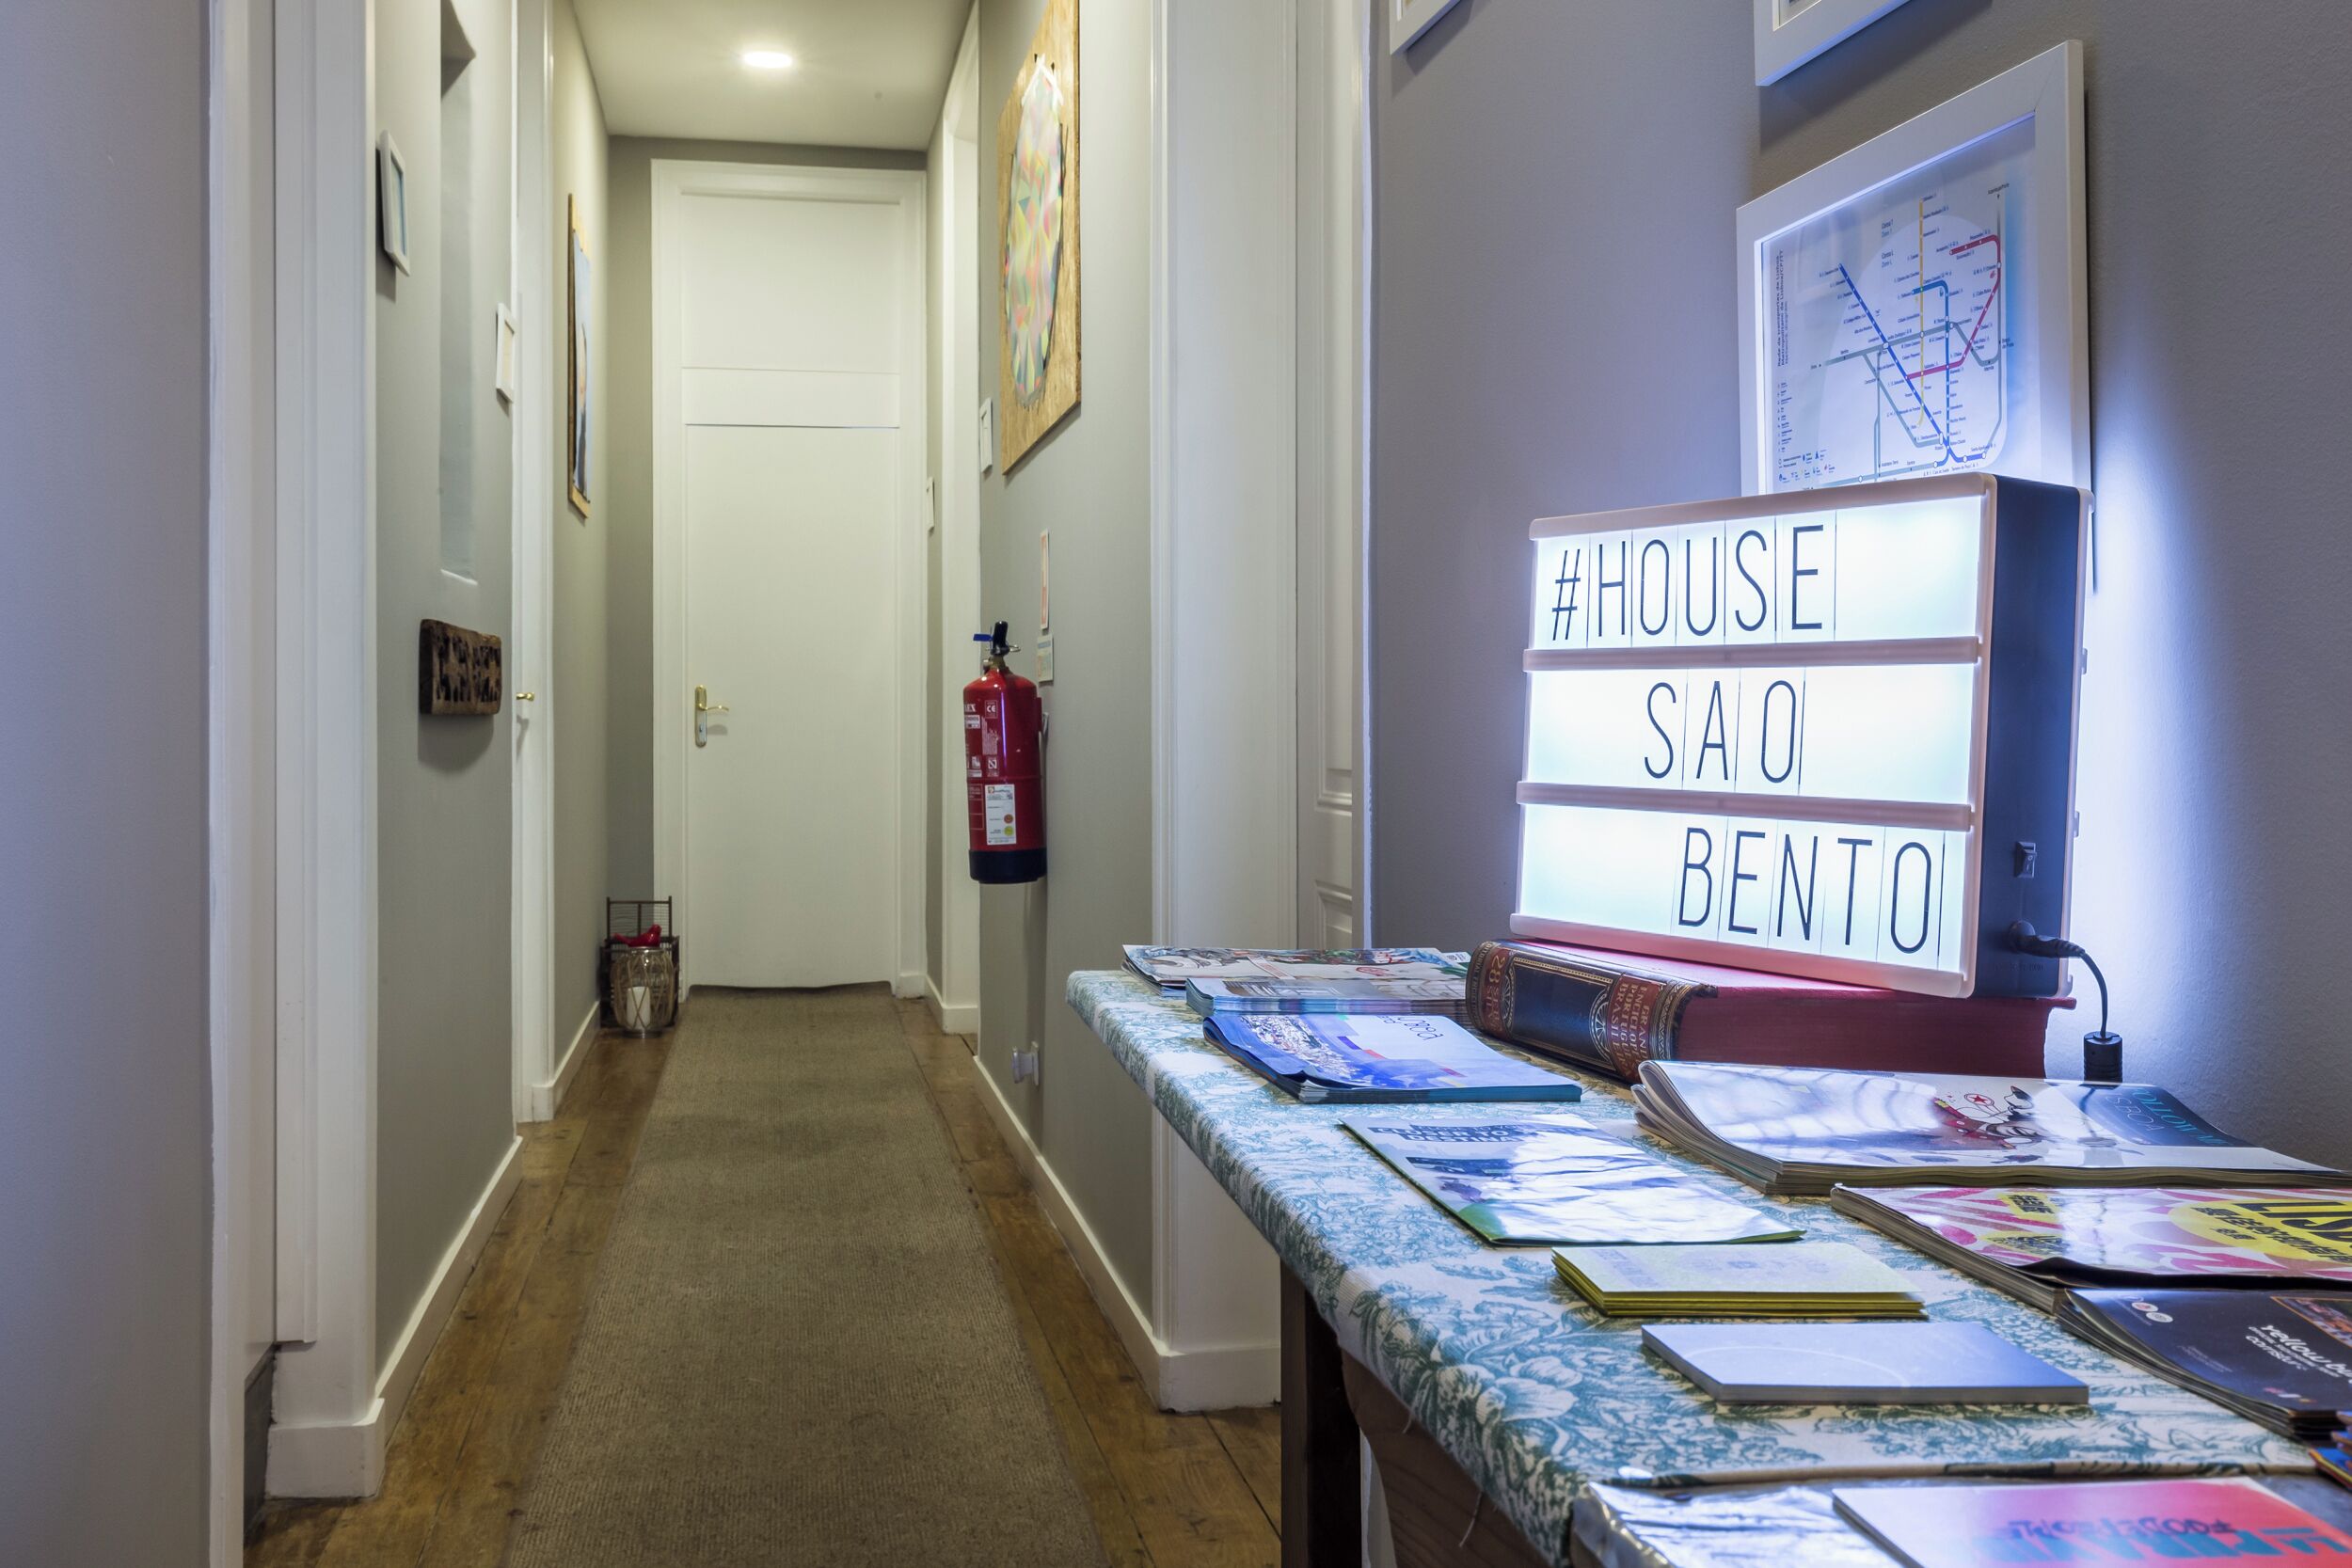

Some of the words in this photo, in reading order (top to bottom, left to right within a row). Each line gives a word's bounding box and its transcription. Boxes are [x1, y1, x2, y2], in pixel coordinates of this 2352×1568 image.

[1551, 524, 1824, 641] #HOUSE
[1644, 680, 1797, 783] SAO
[1678, 827, 1932, 954] BENTO
[1488, 955, 1506, 985] 28
[1638, 1004, 1651, 1061] GRAND
